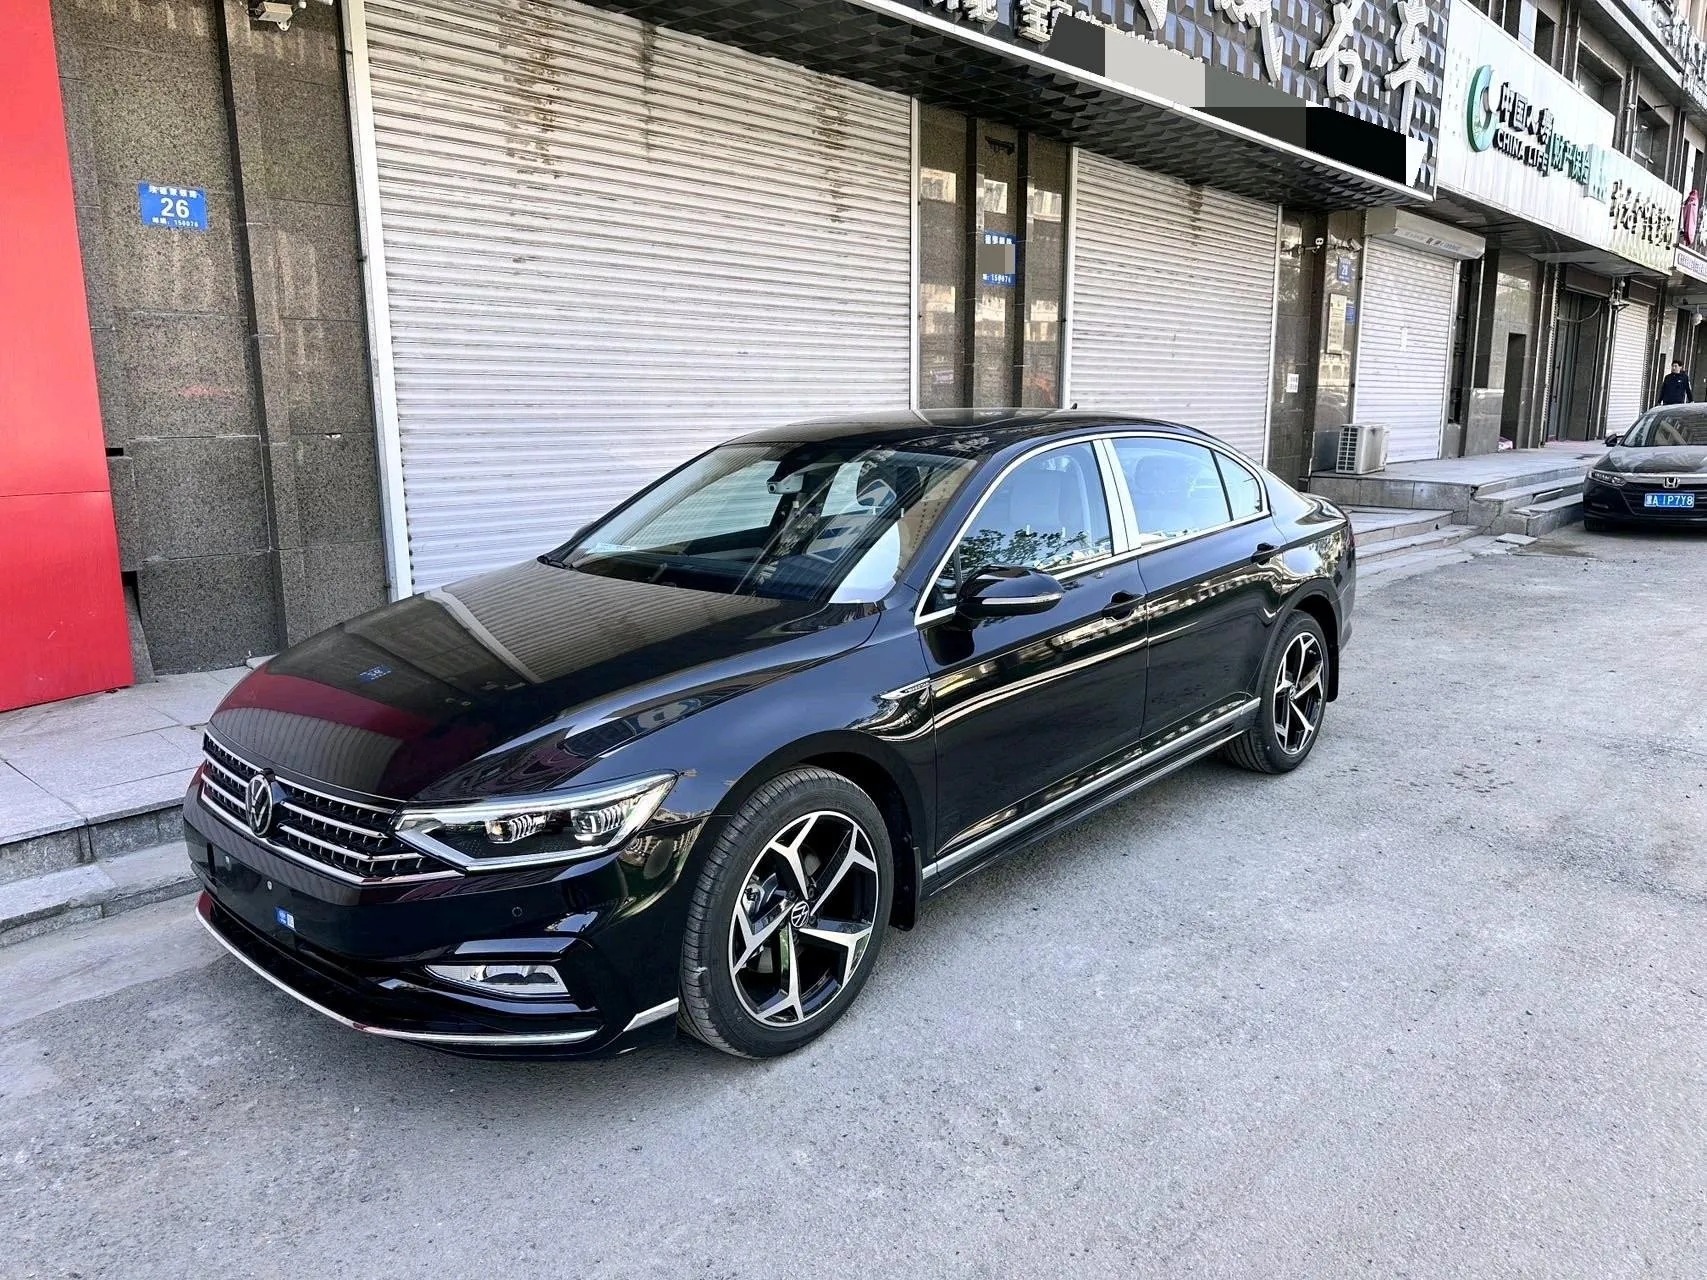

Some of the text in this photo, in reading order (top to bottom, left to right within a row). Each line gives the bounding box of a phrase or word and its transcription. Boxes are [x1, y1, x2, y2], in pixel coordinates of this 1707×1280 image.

[1493, 128, 1550, 178] CHINA LIFE
[160, 197, 190, 219] 26
